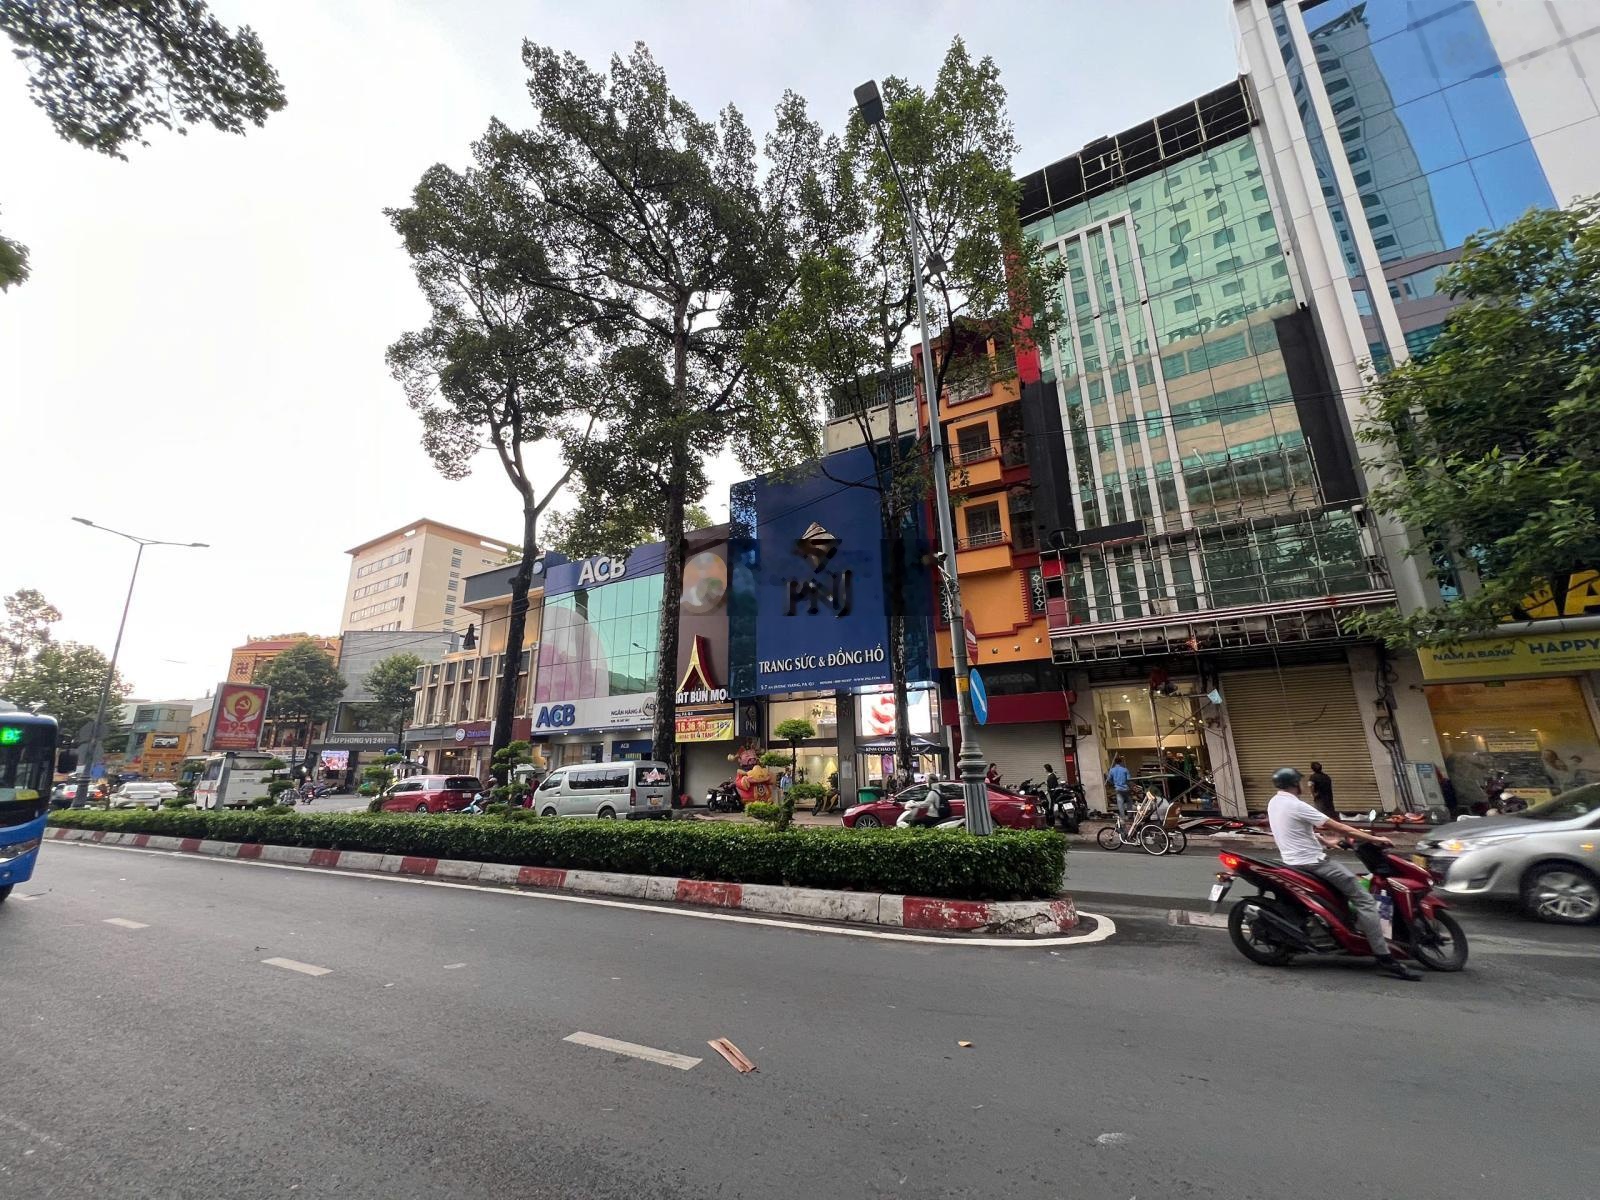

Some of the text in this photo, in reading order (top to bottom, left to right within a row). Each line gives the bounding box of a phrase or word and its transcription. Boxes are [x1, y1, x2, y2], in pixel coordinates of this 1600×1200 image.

[577, 556, 626, 585] ACB
[1434, 651, 1464, 662] NAM
[1477, 649, 1516, 659] BANK
[1528, 637, 1600, 655] HAPPY
[759, 643, 884, 674] TRANG SỨC & ĐỒNG HỒ
[690, 687, 709, 703] BÚN
[536, 704, 576, 728] ACB
